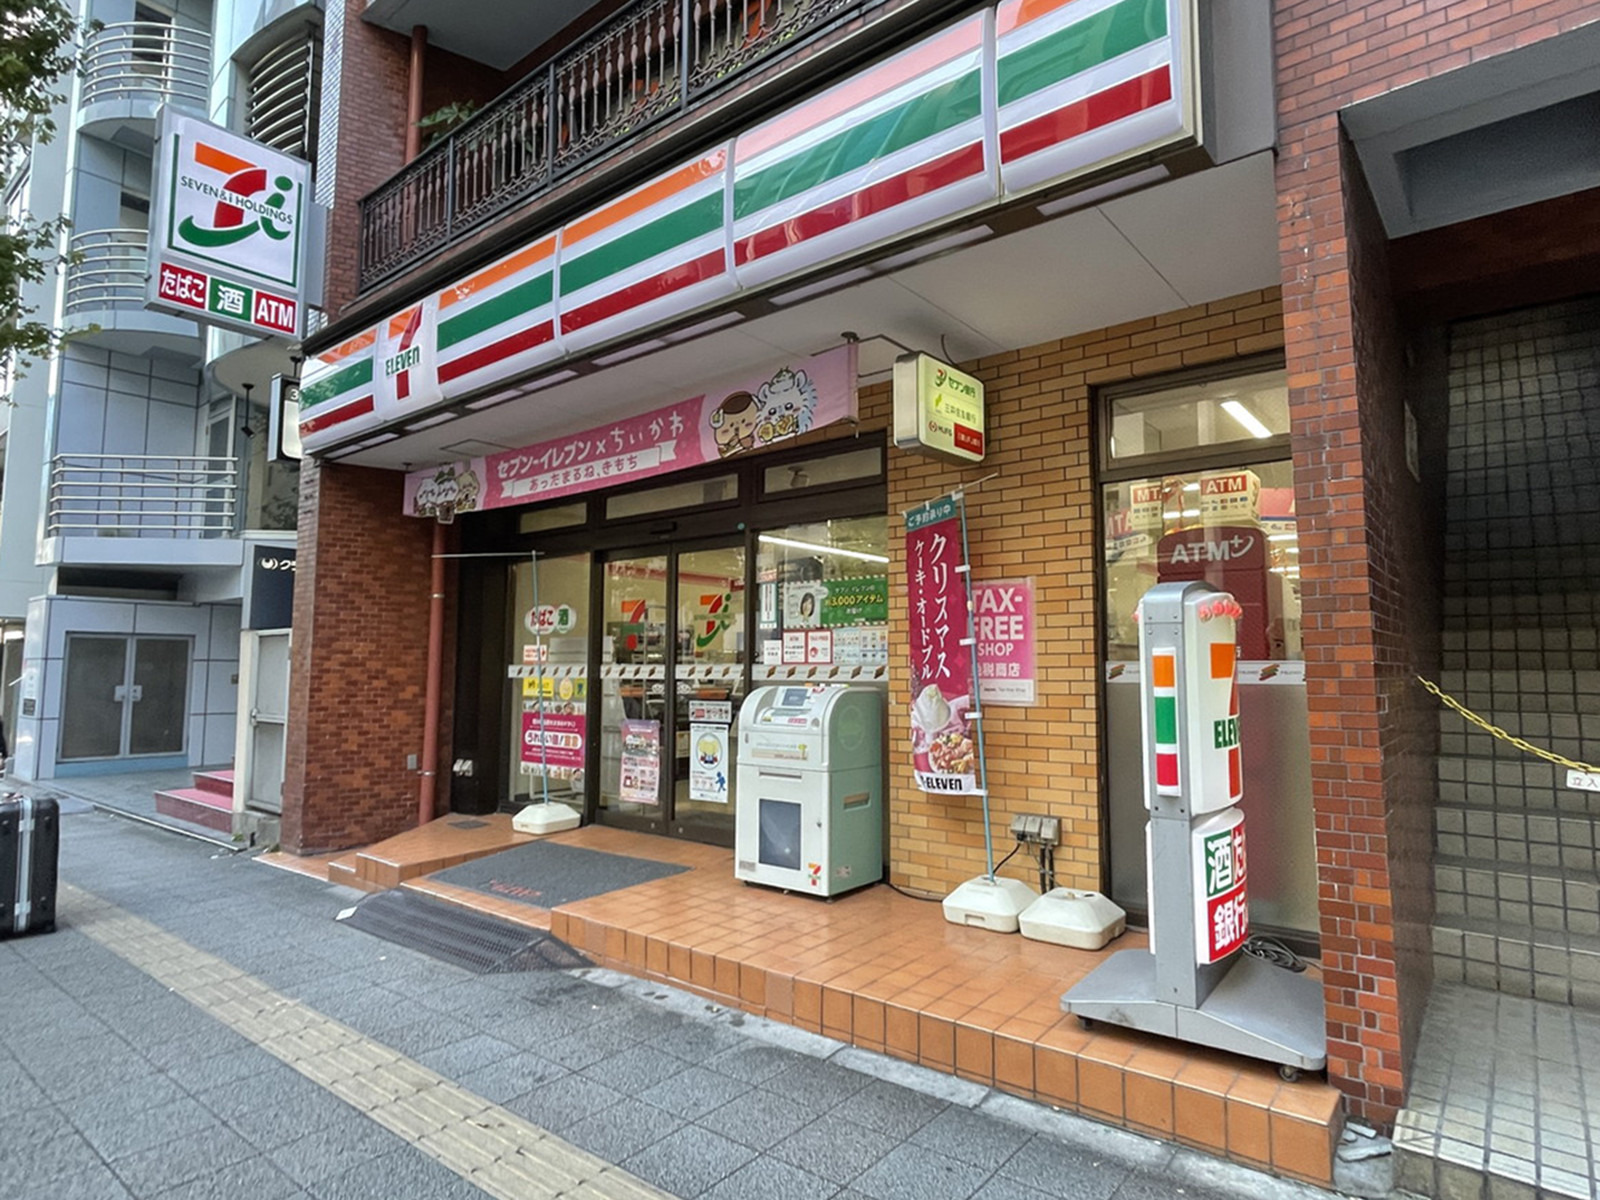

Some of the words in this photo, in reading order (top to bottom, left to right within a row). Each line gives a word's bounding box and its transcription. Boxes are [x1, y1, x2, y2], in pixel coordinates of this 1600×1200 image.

[236, 196, 293, 225] HOLDINGS
[160, 269, 205, 303] たばこ
[217, 285, 246, 314] 酒
[256, 298, 294, 329] ATM
[529, 455, 639, 493] あったまるね、きもち
[1206, 477, 1243, 494] ATM
[929, 533, 951, 679] クリスマス
[978, 642, 1014, 657] SHOP
[1207, 835, 1232, 895] 酒
[1213, 891, 1247, 951] 銀行
